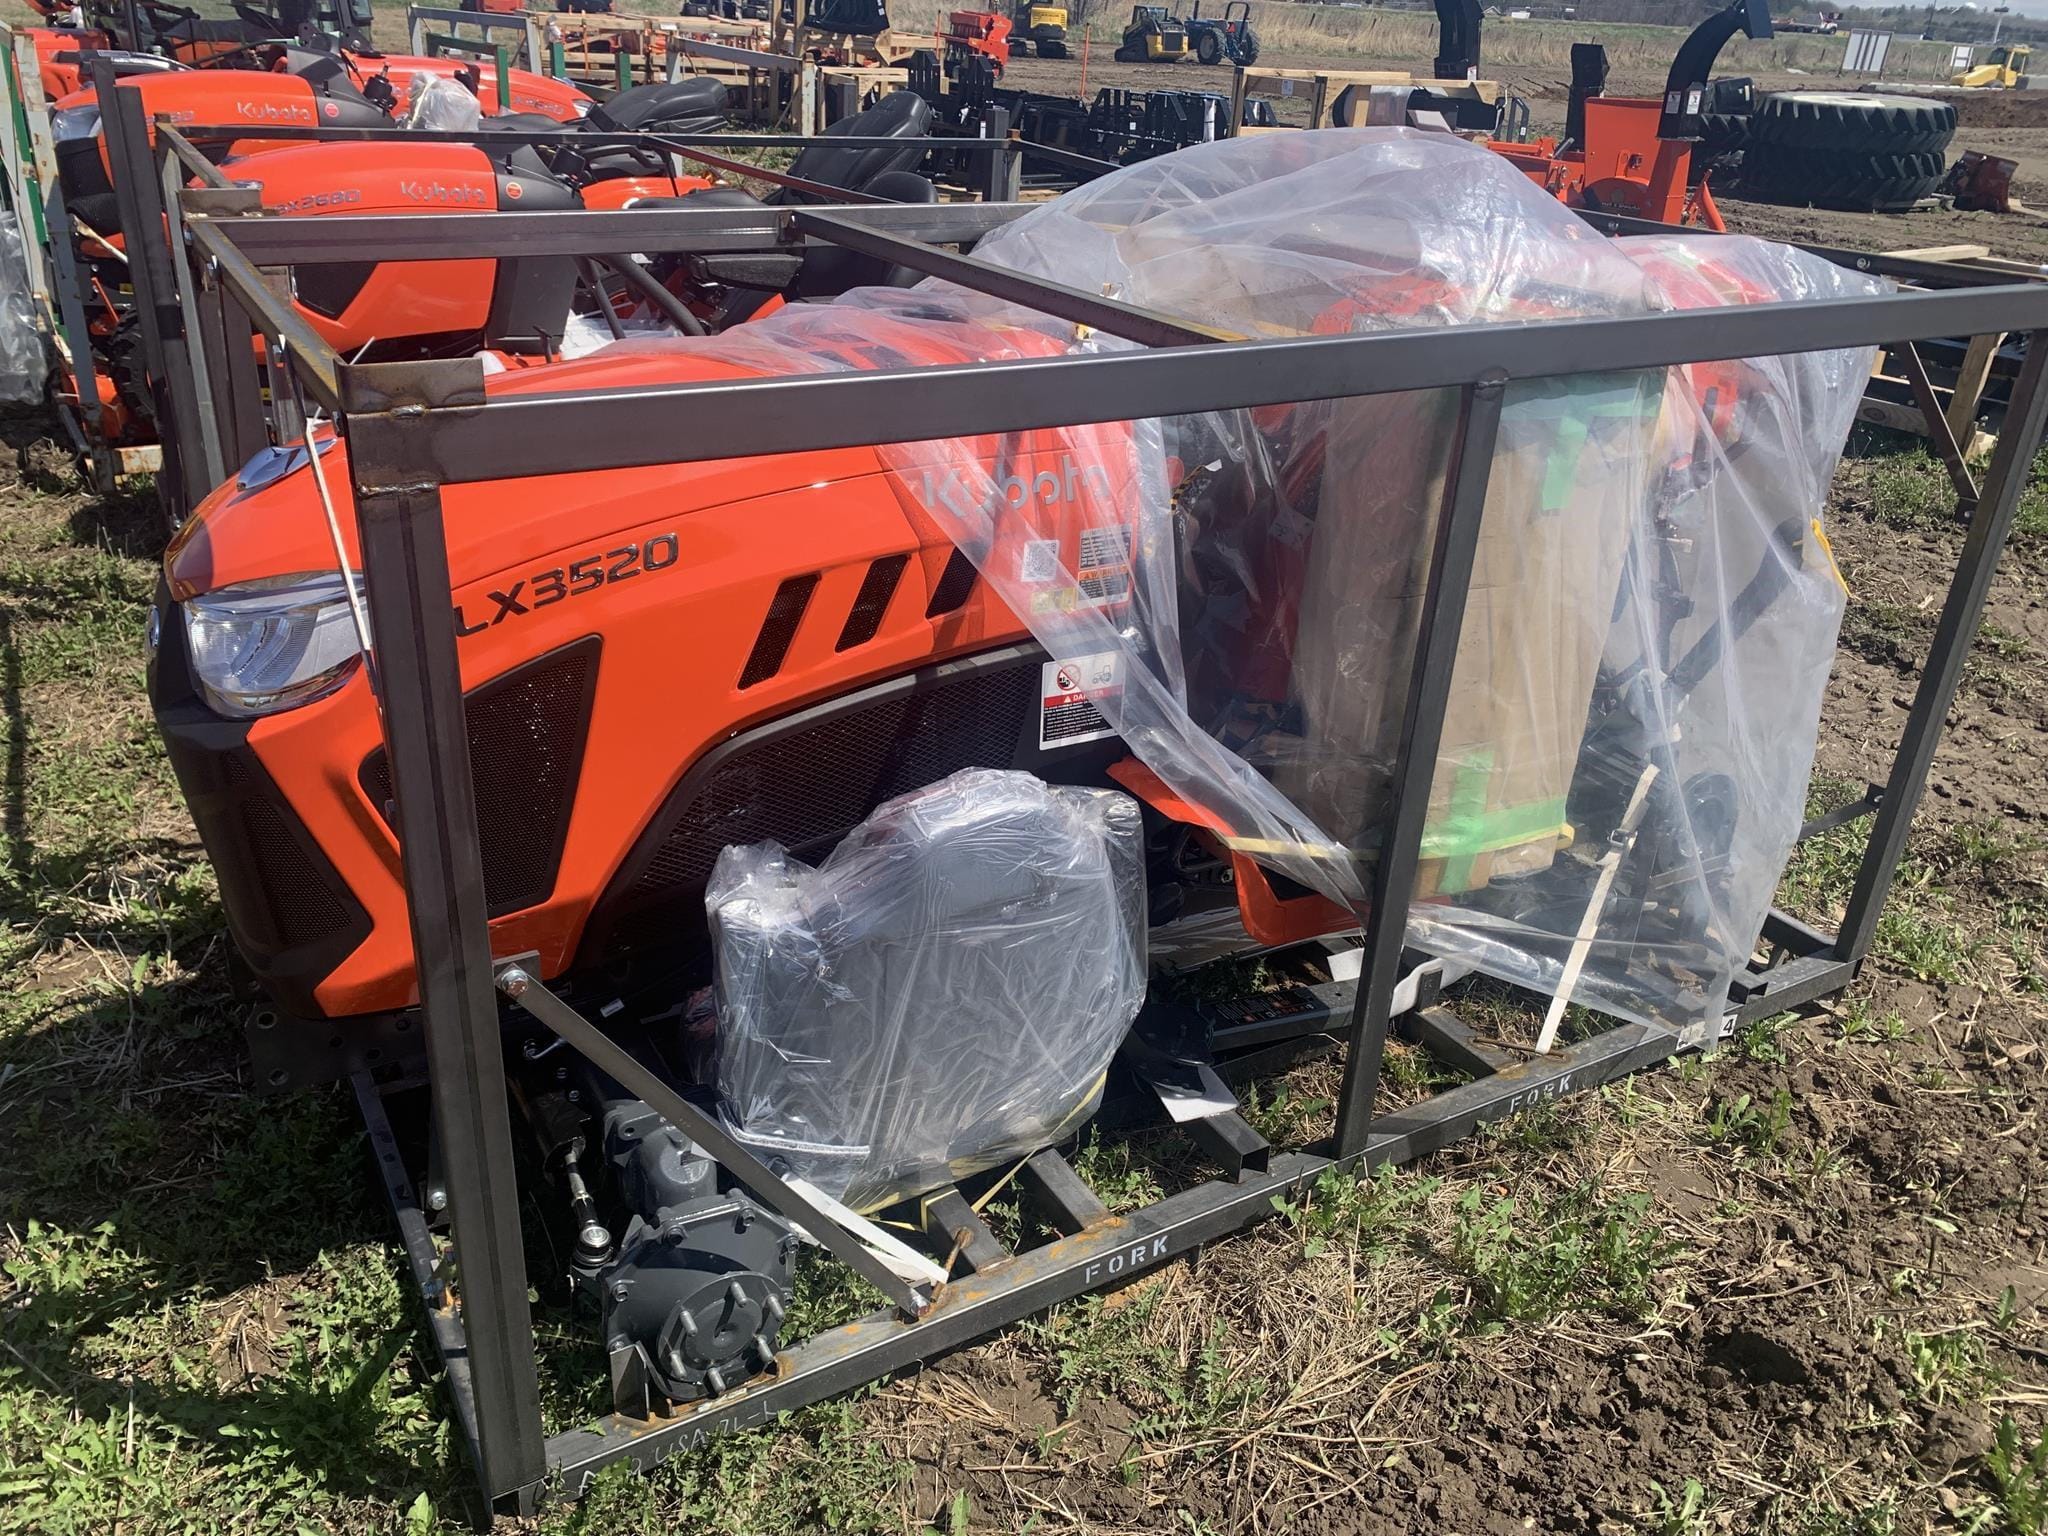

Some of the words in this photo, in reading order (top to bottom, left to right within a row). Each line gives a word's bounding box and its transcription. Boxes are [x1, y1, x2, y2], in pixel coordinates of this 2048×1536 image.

[236, 101, 311, 121] Kubota
[401, 181, 487, 204] Kubota
[922, 454, 1109, 518] Kubota
[453, 532, 679, 637] LX3520
[1510, 1073, 1572, 1113] FORK
[1085, 1235, 1168, 1284] FORK
